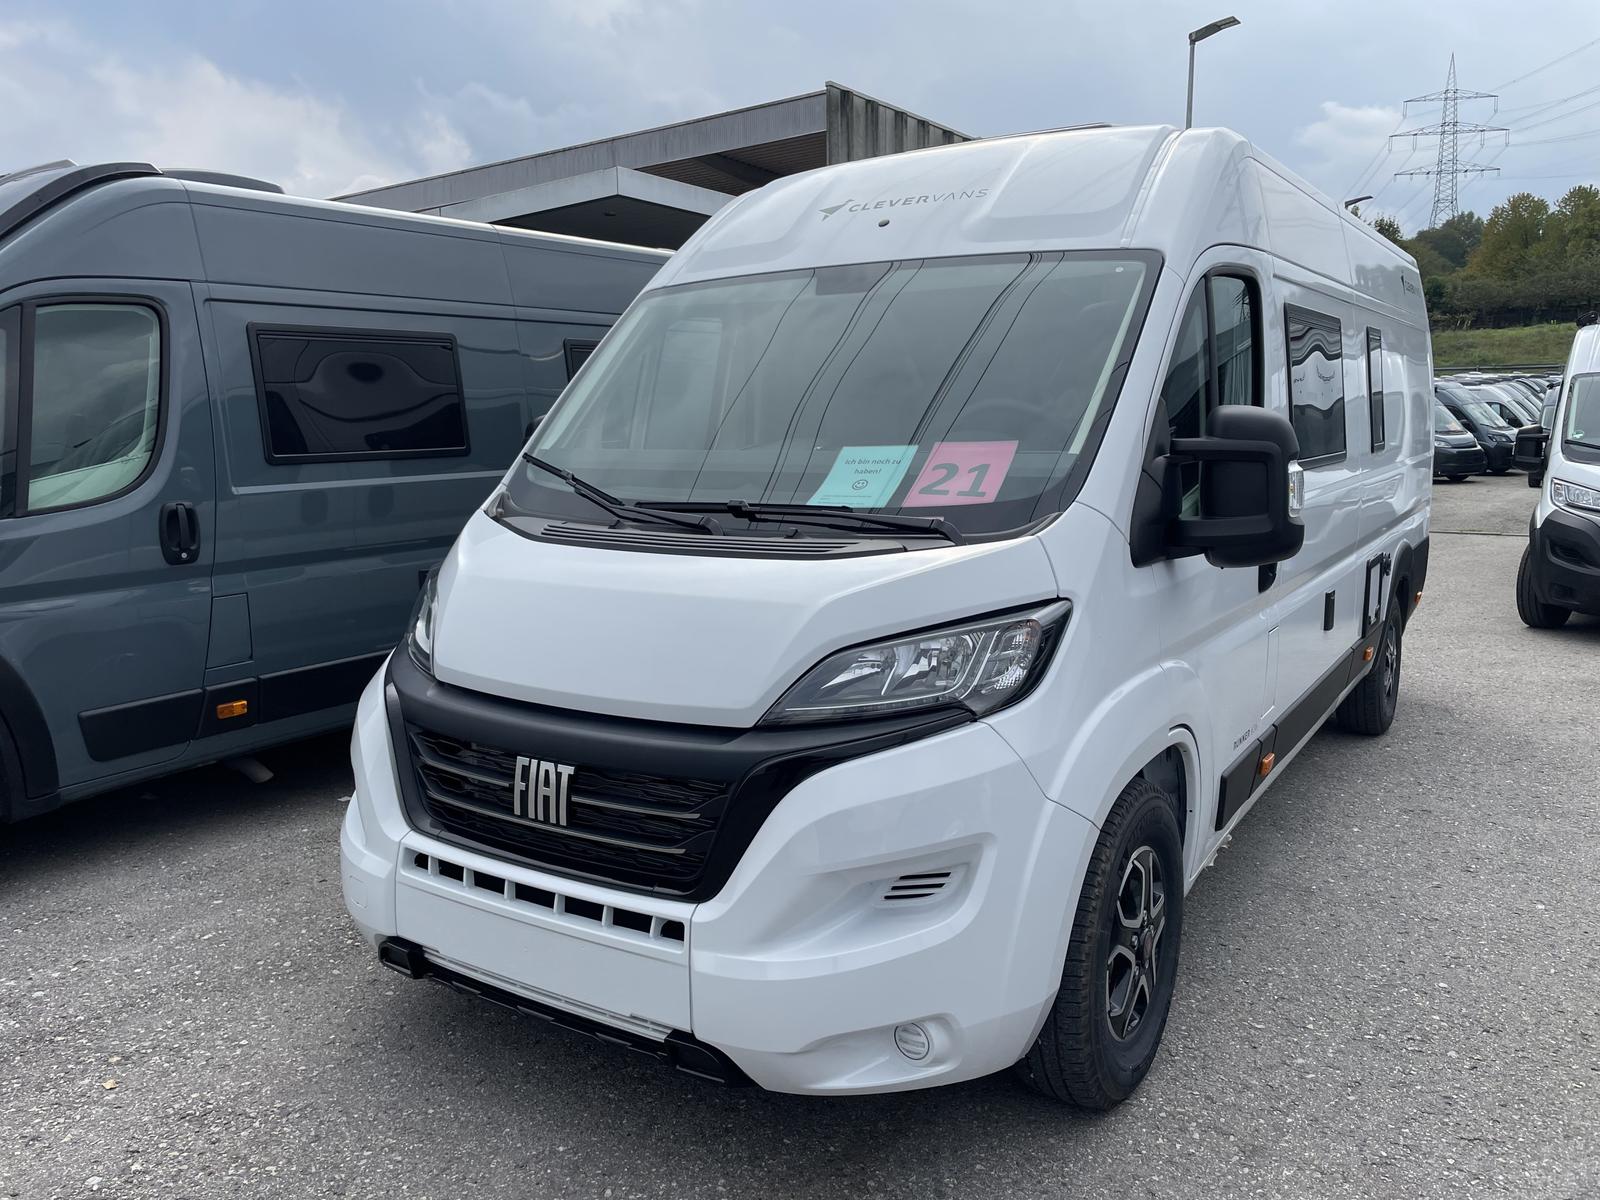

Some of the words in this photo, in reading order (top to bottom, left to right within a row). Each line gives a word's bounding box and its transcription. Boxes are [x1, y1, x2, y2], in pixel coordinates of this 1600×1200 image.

[848, 188, 990, 213] CLEVERVANS
[918, 463, 991, 497] 21
[513, 755, 575, 827] FIAT
